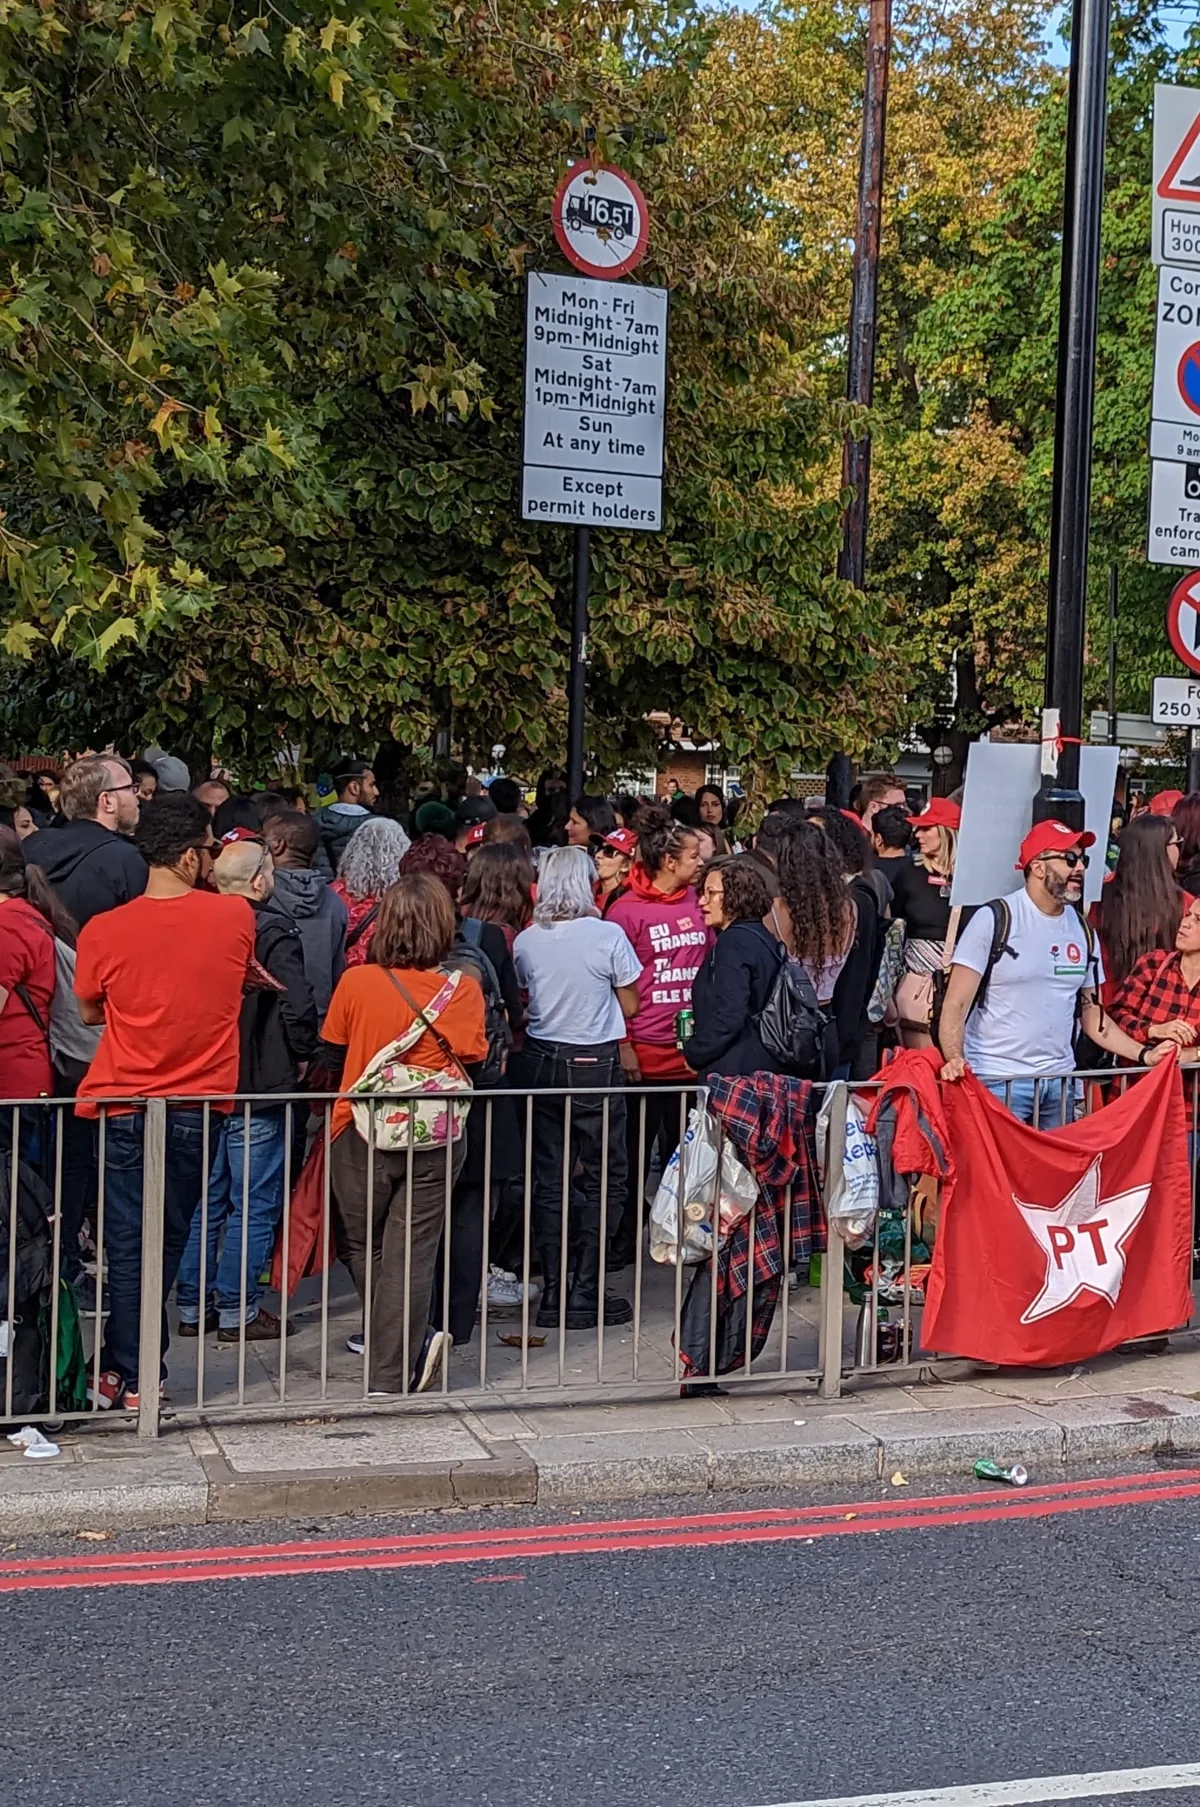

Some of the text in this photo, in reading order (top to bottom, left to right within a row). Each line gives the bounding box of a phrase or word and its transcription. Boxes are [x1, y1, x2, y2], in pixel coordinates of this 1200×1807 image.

[562, 290, 598, 311] Mon
[612, 297, 635, 315] Fri
[582, 354, 612, 373] Sat
[579, 416, 613, 434] Sun
[542, 431, 646, 456] At any time
[562, 476, 623, 498] Except
[527, 499, 656, 522] permit holders
[1159, 701, 1191, 717] 250
[649, 923, 670, 939] EU
[651, 931, 706, 953] TRANSO
[653, 966, 699, 985] TRANS
[652, 989, 681, 1004] ELE
[1047, 1218, 1108, 1270] PT
